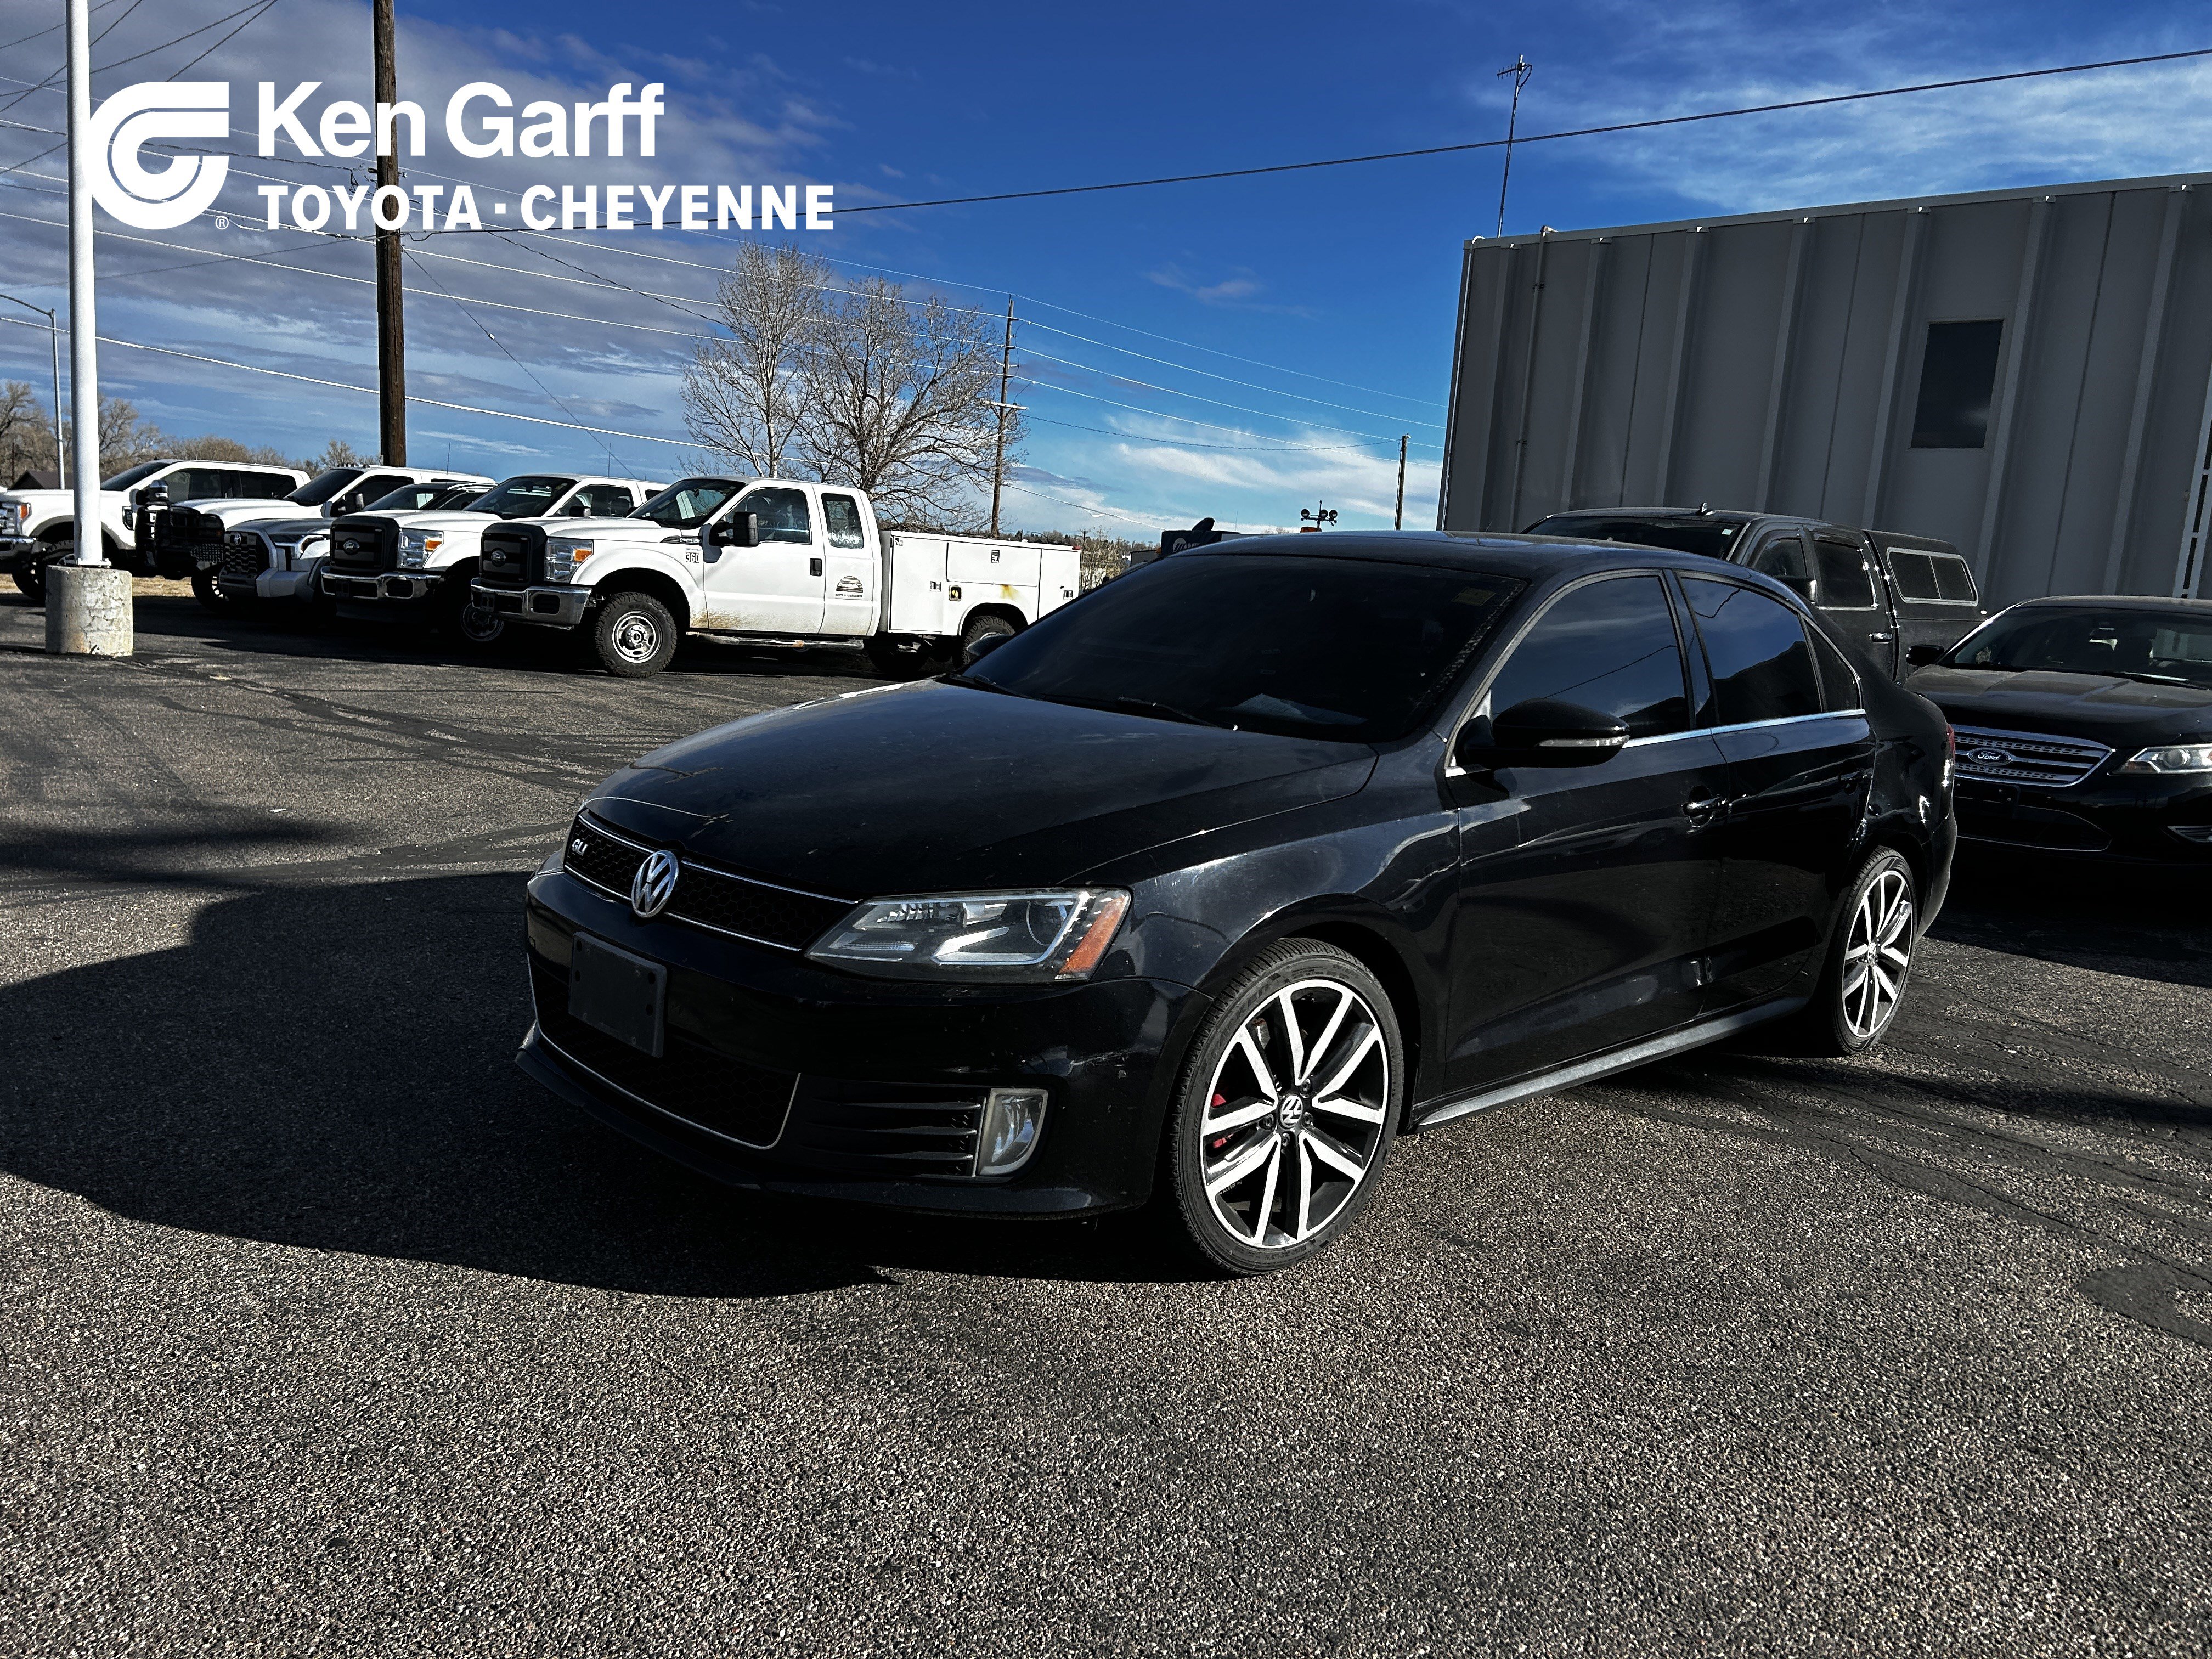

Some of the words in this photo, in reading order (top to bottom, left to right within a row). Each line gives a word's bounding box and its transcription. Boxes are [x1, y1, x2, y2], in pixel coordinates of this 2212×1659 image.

[685, 552, 700, 563] 360
[1977, 751, 2001, 761] Ford
[572, 839, 588, 856] GLI
